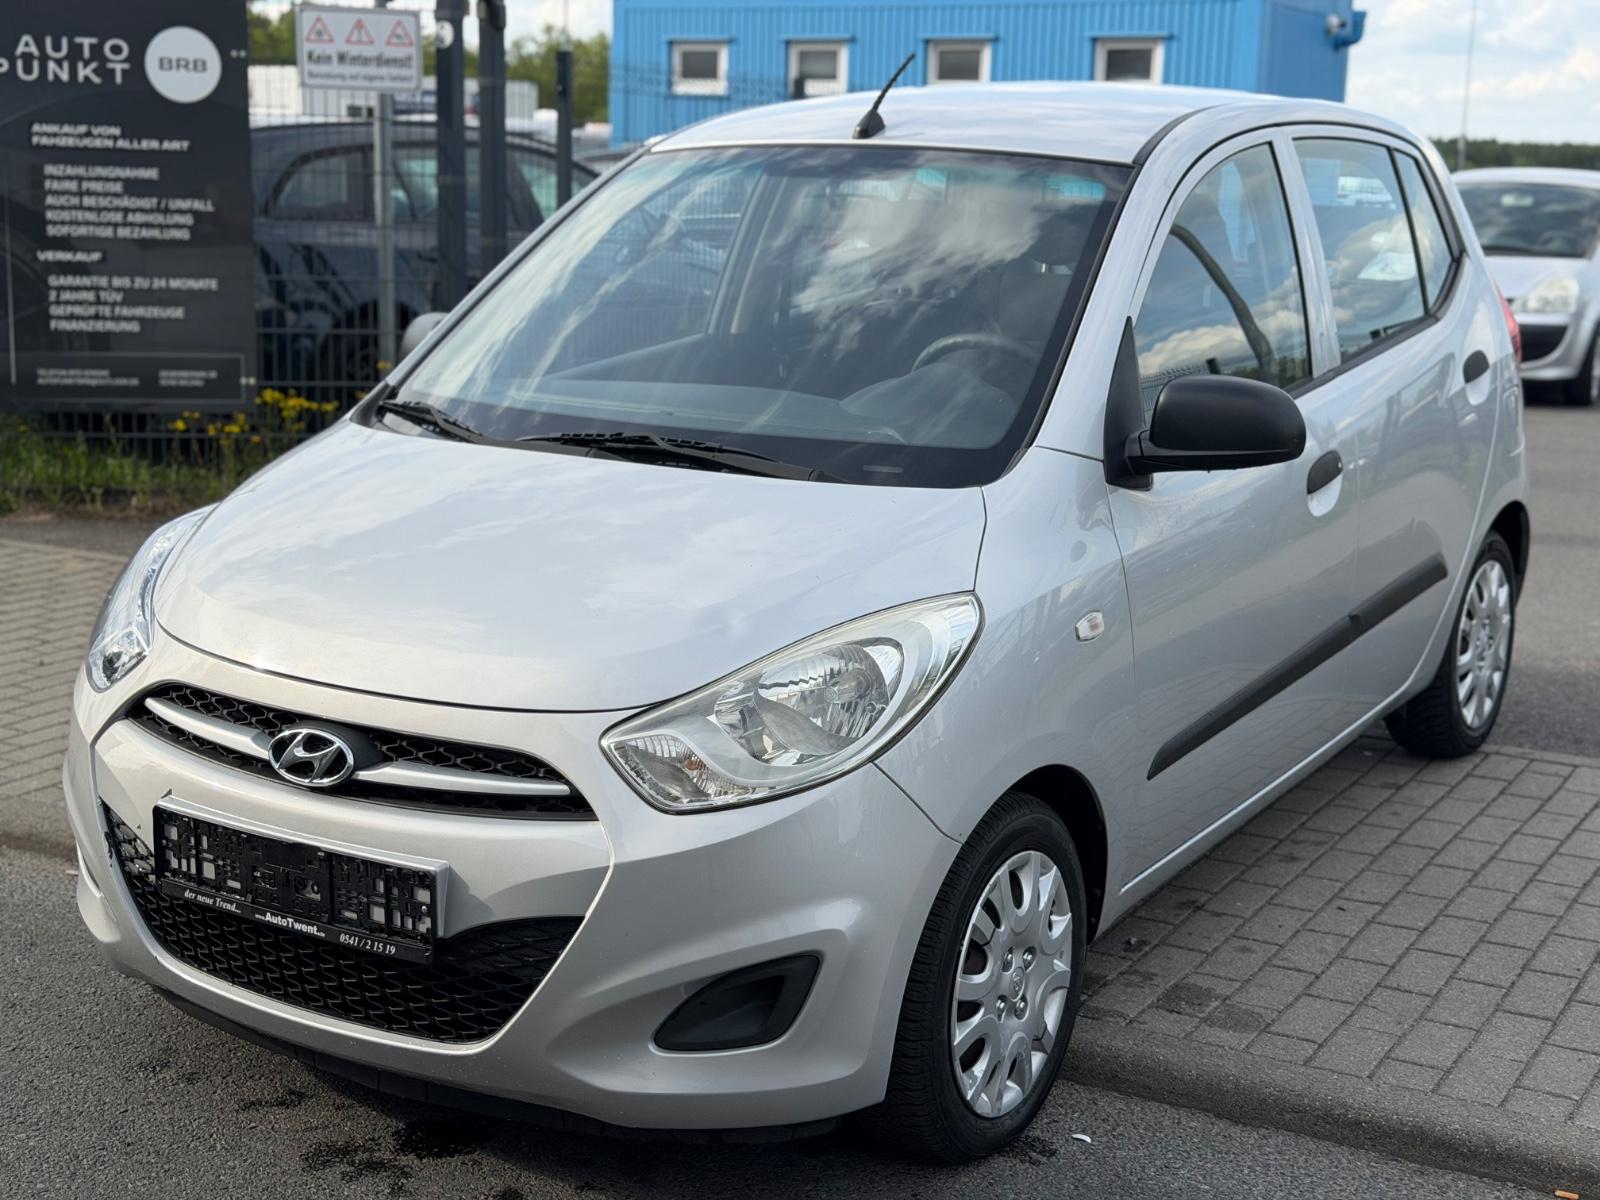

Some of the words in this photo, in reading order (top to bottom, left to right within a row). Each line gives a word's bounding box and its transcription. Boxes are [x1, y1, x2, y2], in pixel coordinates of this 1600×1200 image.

[15, 34, 130, 61] AUTO
[307, 50, 332, 64] Kein
[158, 56, 208, 73] BRB
[31, 123, 89, 135] ANKAUF
[90, 125, 121, 136] VON
[115, 138, 160, 150] ALLER
[161, 140, 190, 151] ART
[44, 179, 79, 192] FAIRE
[81, 180, 124, 193] PREISE
[45, 195, 80, 208] AUCH
[45, 209, 124, 222] KOSTENLOSE
[126, 211, 194, 226] ABHOLUNG
[46, 224, 115, 238] SOFORTIGE
[116, 226, 191, 240] BEZAHLUNG
[36, 250, 102, 262] VERKAUF
[48, 275, 109, 288] GARANTIE
[169, 278, 218, 291] MONATE
[59, 290, 97, 303] JAHRE
[49, 319, 141, 333] FINANZIERUNG
[184, 889, 195, 899] der
[197, 895, 214, 906] neue
[339, 933, 359, 947] 0541
[366, 939, 371, 949] 2
[373, 943, 384, 953] 15
[386, 945, 396, 955] 19
